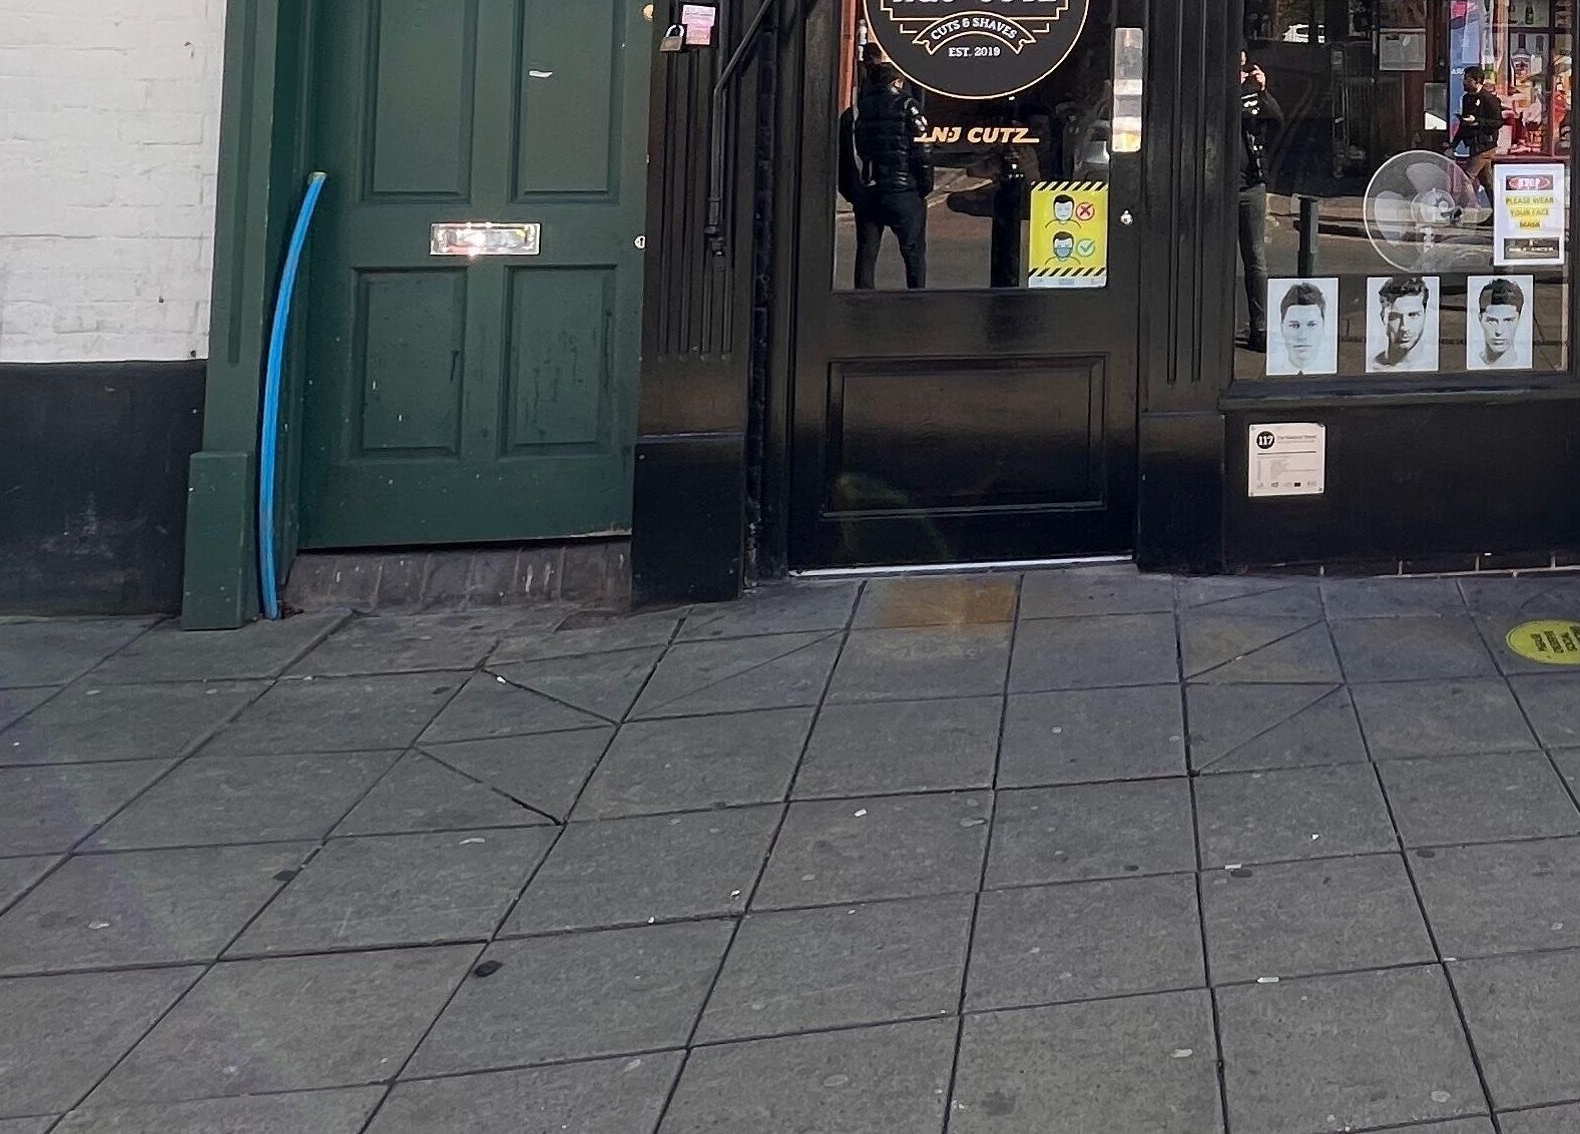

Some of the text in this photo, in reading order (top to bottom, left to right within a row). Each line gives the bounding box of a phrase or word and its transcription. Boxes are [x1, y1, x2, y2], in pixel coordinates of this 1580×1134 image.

[930, 19, 960, 40] CUTS
[972, 17, 1018, 39] SHAVES
[974, 47, 1000, 57] 2019
[967, 127, 1030, 144] CUTZ
[1258, 435, 1275, 446] 117
